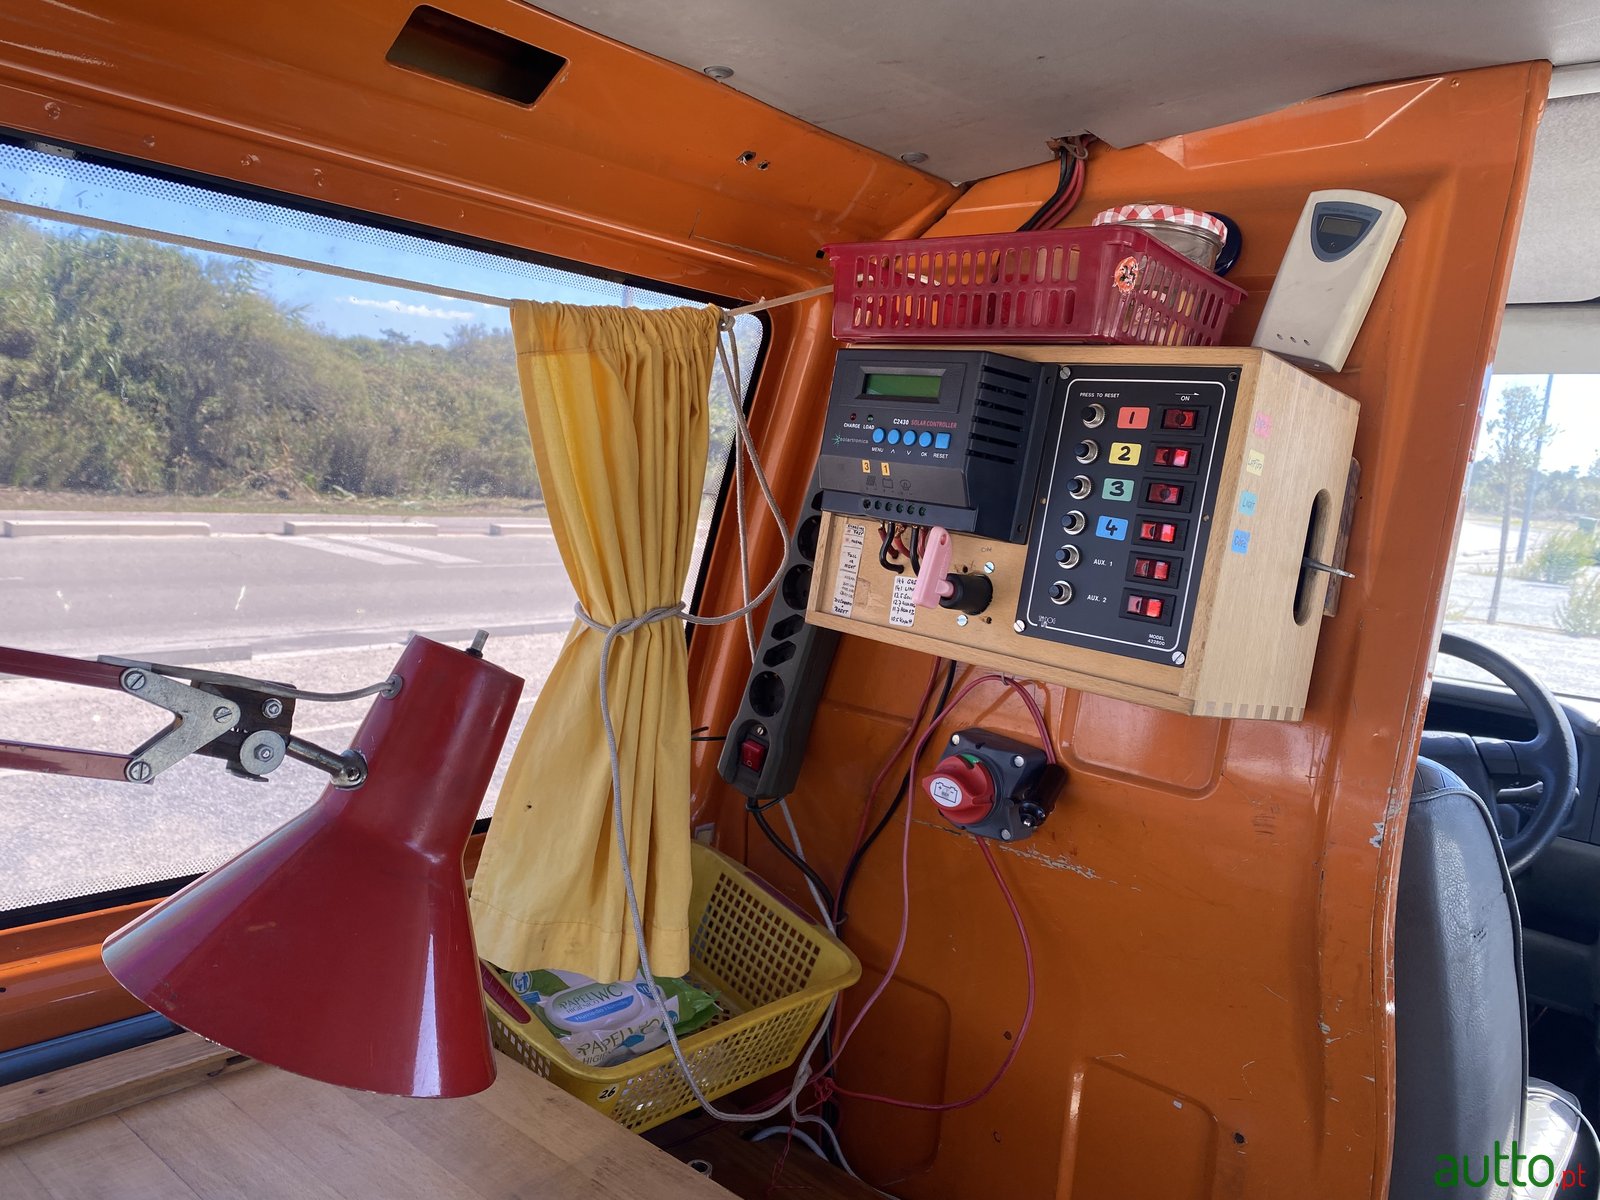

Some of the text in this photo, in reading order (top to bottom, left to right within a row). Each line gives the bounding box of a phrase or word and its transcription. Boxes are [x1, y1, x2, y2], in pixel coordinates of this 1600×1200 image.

[893, 418, 958, 429] C2430 SOLAR CONTROLLER
[1129, 411, 1135, 425] 1
[1117, 445, 1131, 461] 2
[864, 462, 870, 471] 3
[1109, 480, 1125, 497] 3
[1105, 519, 1118, 536] 4
[1093, 558, 1107, 567] AUX.
[1086, 594, 1101, 602] AUX.
[1149, 633, 1165, 641] MODEL
[590, 984, 623, 1001] WC
[598, 1086, 616, 1099] 26
